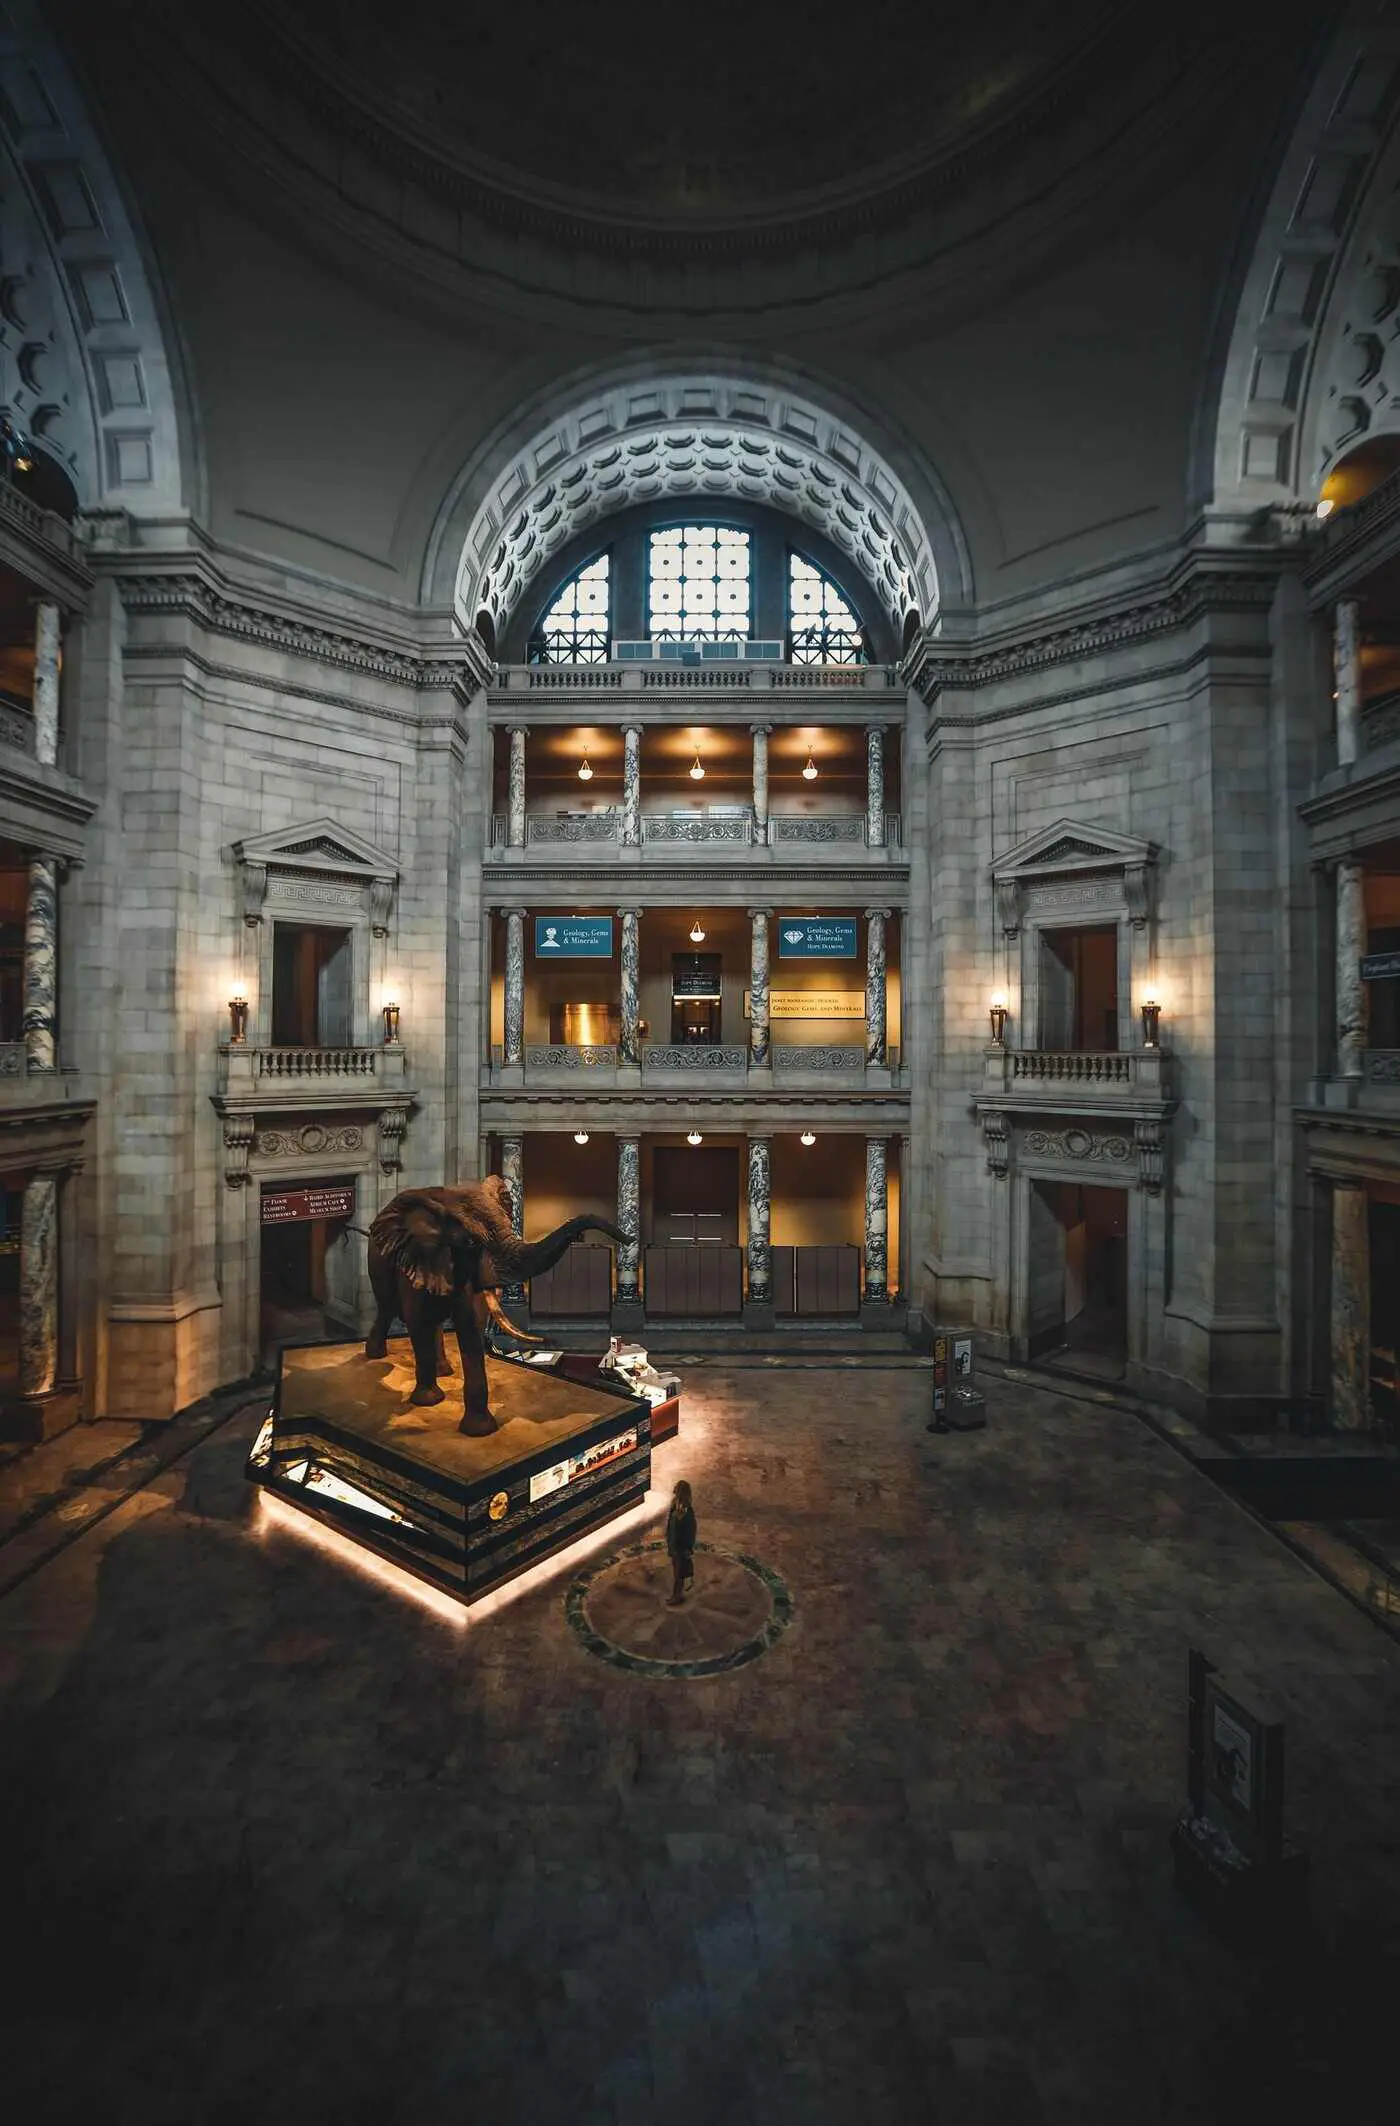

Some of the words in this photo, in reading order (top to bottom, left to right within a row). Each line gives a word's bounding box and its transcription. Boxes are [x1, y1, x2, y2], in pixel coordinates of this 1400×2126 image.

[563, 928, 590, 938] Geology,
[591, 928, 609, 936] Gems
[806, 926, 834, 935] Geology,
[835, 926, 853, 934] Gems
[815, 934, 842, 942] Minerals
